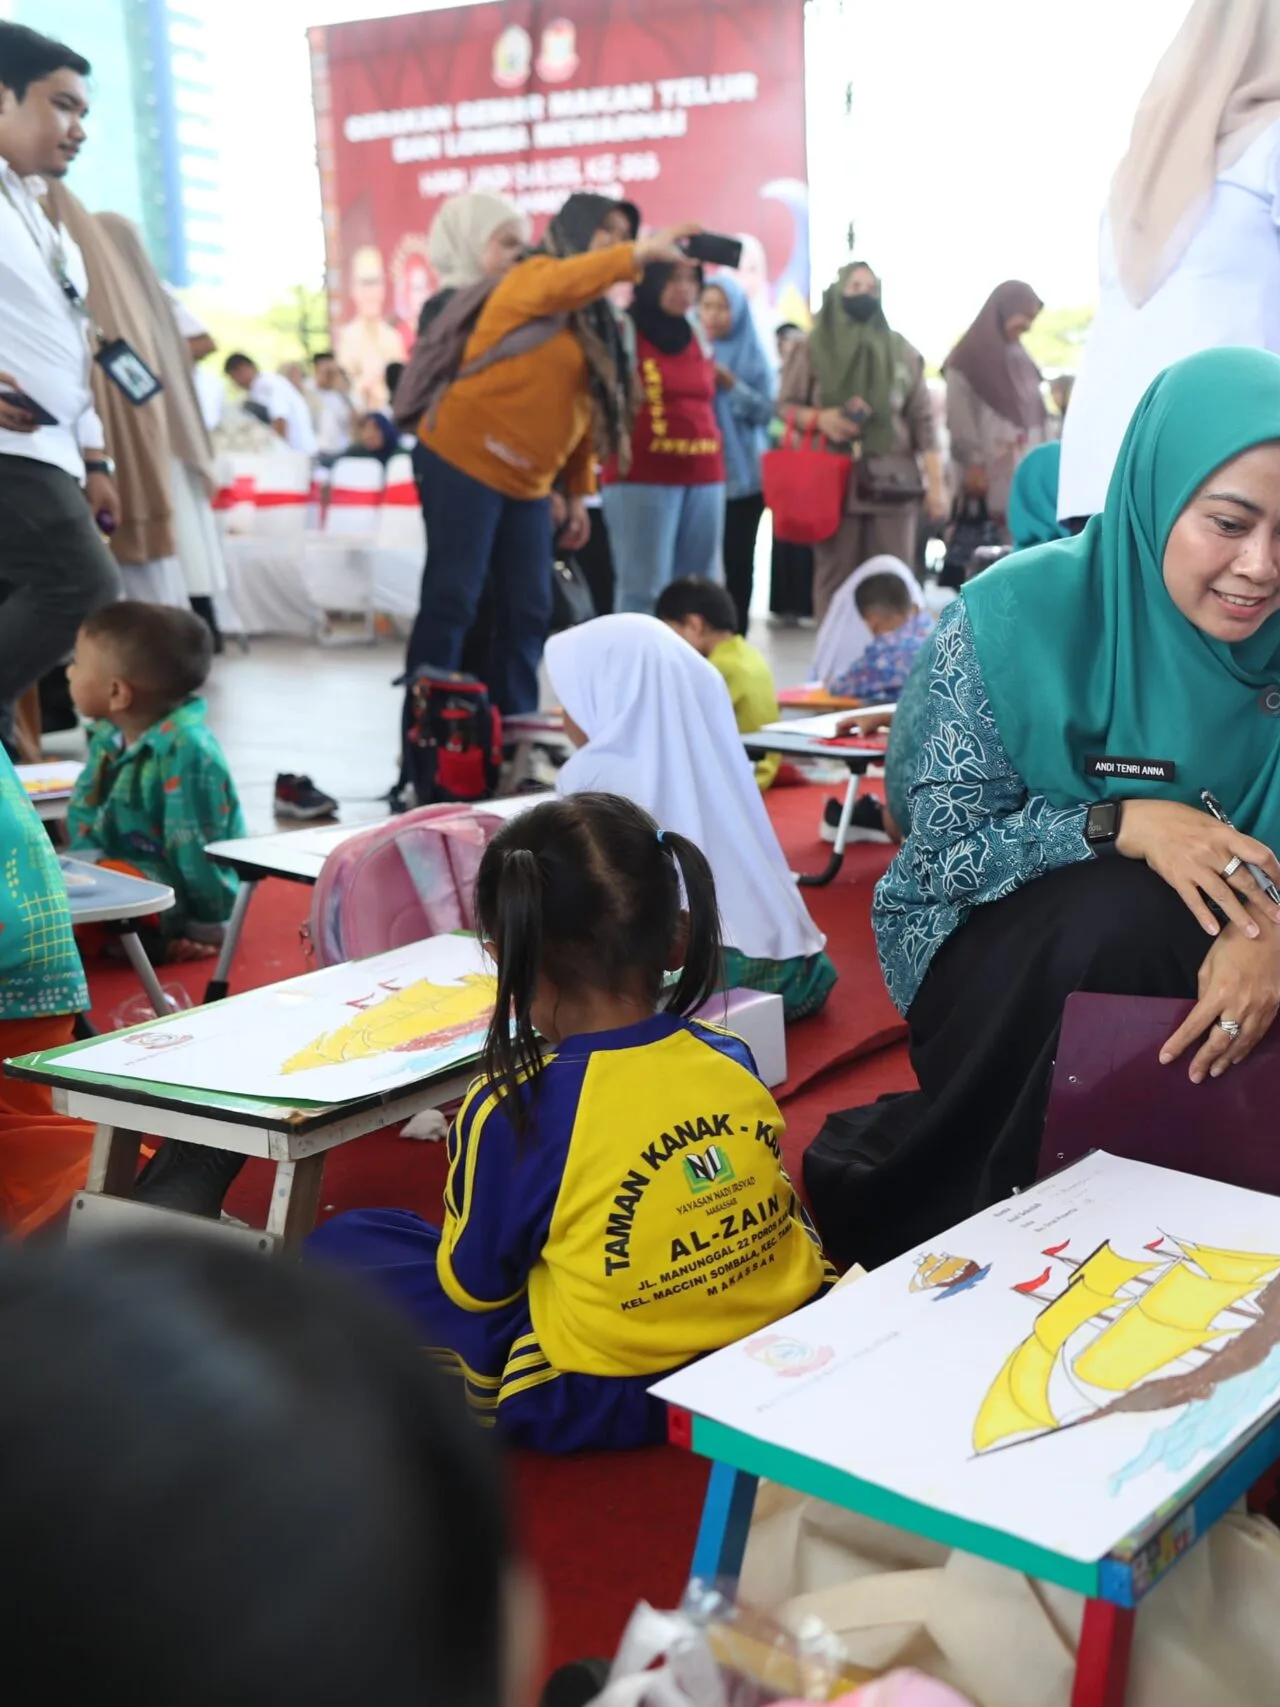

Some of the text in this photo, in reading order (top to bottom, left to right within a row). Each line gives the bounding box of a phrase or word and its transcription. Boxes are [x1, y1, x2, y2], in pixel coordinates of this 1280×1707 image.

[1095, 761, 1165, 776] ANDI TENRI ANNA
[605, 1169, 651, 1277] TAMAN
[640, 1114, 735, 1171] KANAK
[670, 1193, 780, 1262] AL-ZAIN
[676, 1193, 713, 1215] YAYASAN
[713, 1187, 731, 1200] NADI
[621, 1297, 650, 1311] KEL.
[653, 1274, 707, 1301] MACCINI
[710, 1250, 760, 1279] SOMBALA,
[638, 1280, 657, 1291] JL.
[660, 1246, 735, 1283] MANUNGGAL
[737, 1238, 750, 1250] 22
[751, 1221, 777, 1243] POROS
